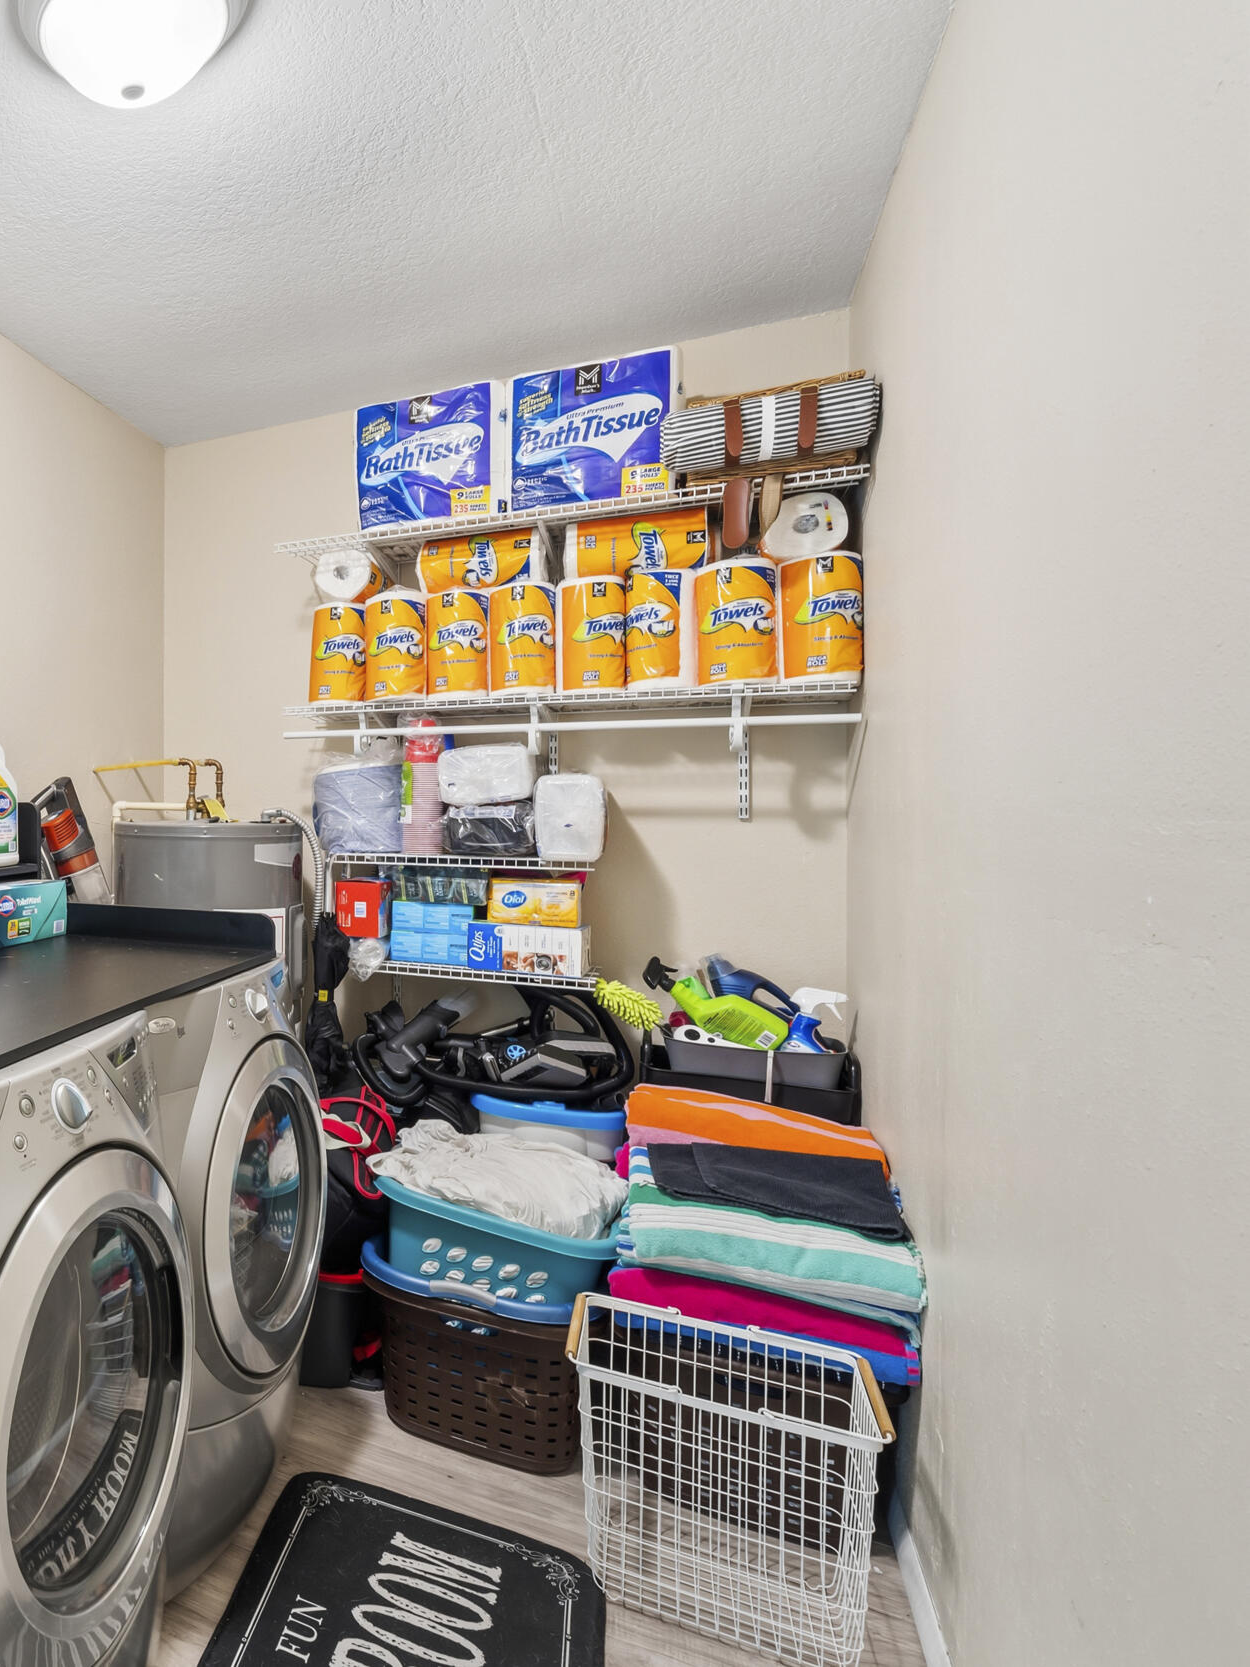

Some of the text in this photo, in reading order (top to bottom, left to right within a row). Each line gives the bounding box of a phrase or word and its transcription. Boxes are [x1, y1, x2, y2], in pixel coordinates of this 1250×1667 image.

[457, 491, 464, 500] 9
[625, 484, 643, 494] 235
[454, 504, 469, 513] 235
[475, 540, 493, 577] Towels
[710, 602, 765, 627] Towels
[808, 596, 861, 617] Towels
[436, 625, 478, 644] Towels
[505, 620, 548, 638] Towels
[324, 639, 360, 655] Towels
[376, 631, 415, 650] Towels
[504, 894, 525, 905] Dial
[275, 1594, 328, 1664] FUN
